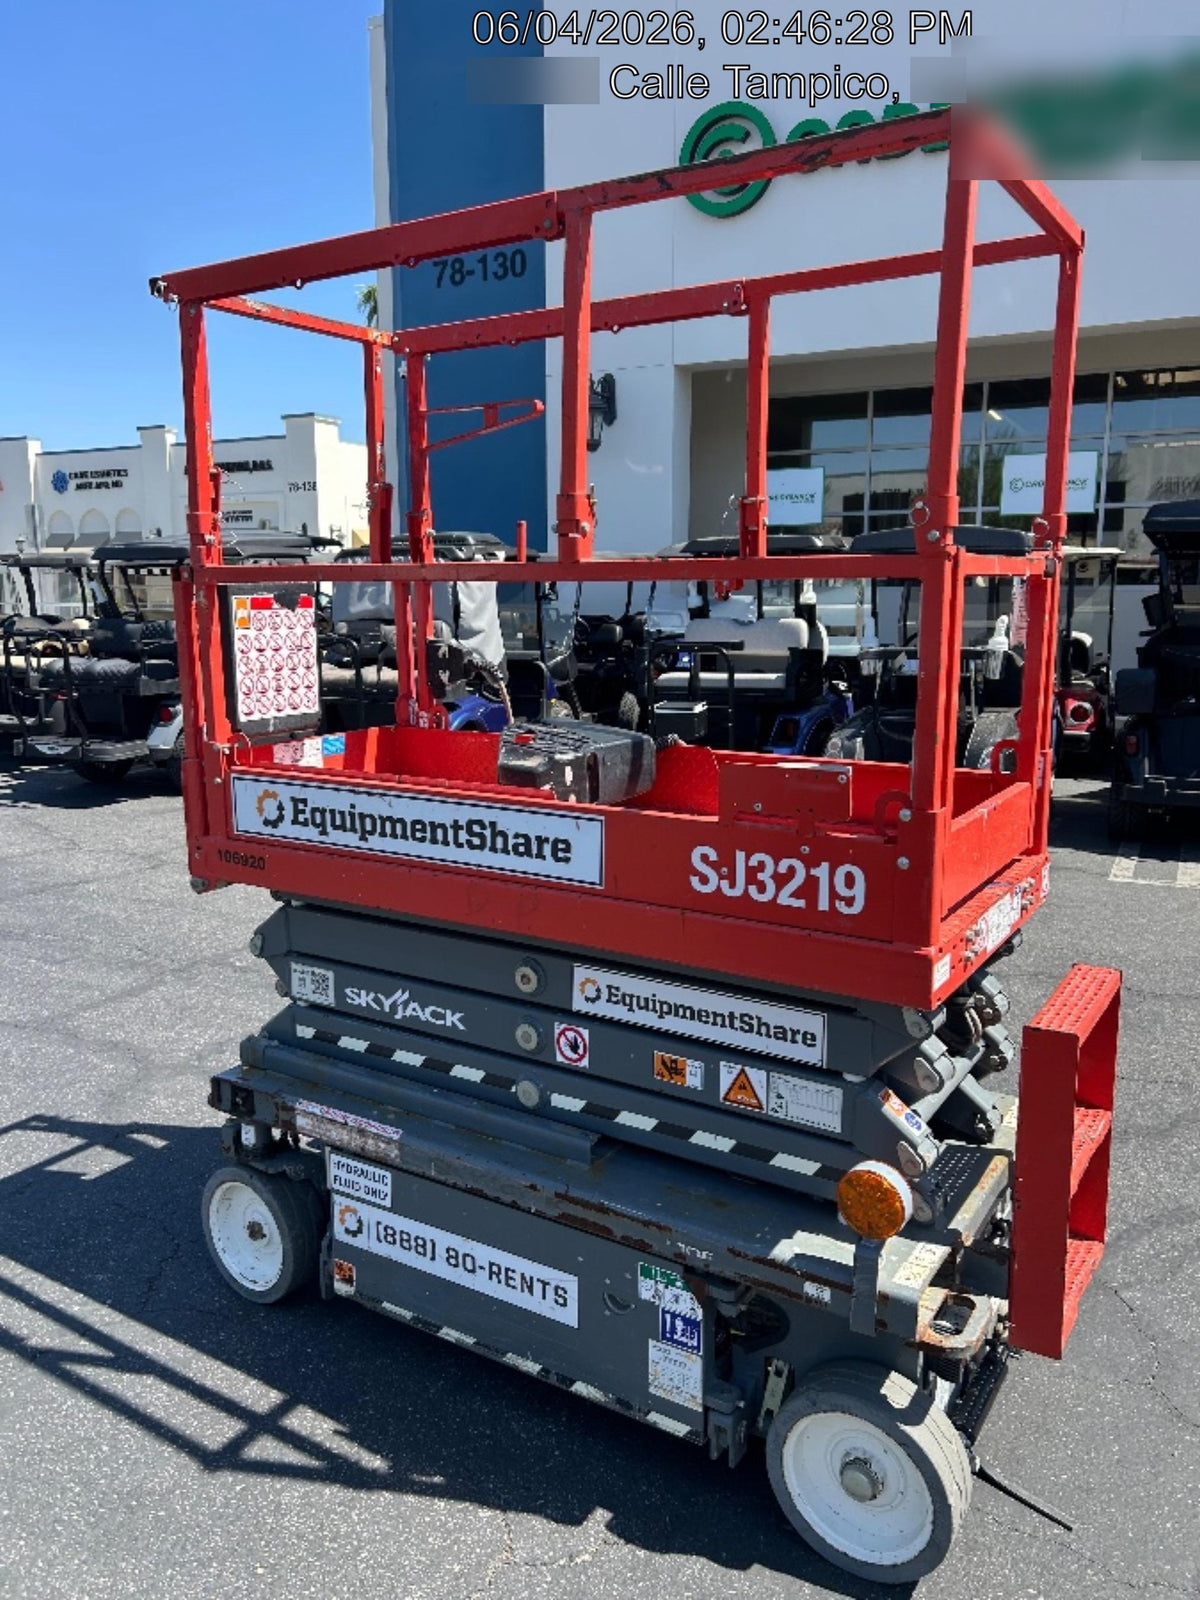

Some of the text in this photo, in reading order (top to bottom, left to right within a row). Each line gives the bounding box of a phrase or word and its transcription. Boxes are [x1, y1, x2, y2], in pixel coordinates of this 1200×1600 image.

[432, 248, 528, 289] 78-130
[289, 797, 573, 865] EquipmentShare
[216, 848, 266, 871] 106920
[689, 845, 867, 915] SJ3219
[344, 986, 466, 1031] SKYJACK
[606, 984, 818, 1049] EquipmentShare
[333, 1174, 389, 1201] FLUID ONLY
[445, 1247, 569, 1308] 80-RENTS
